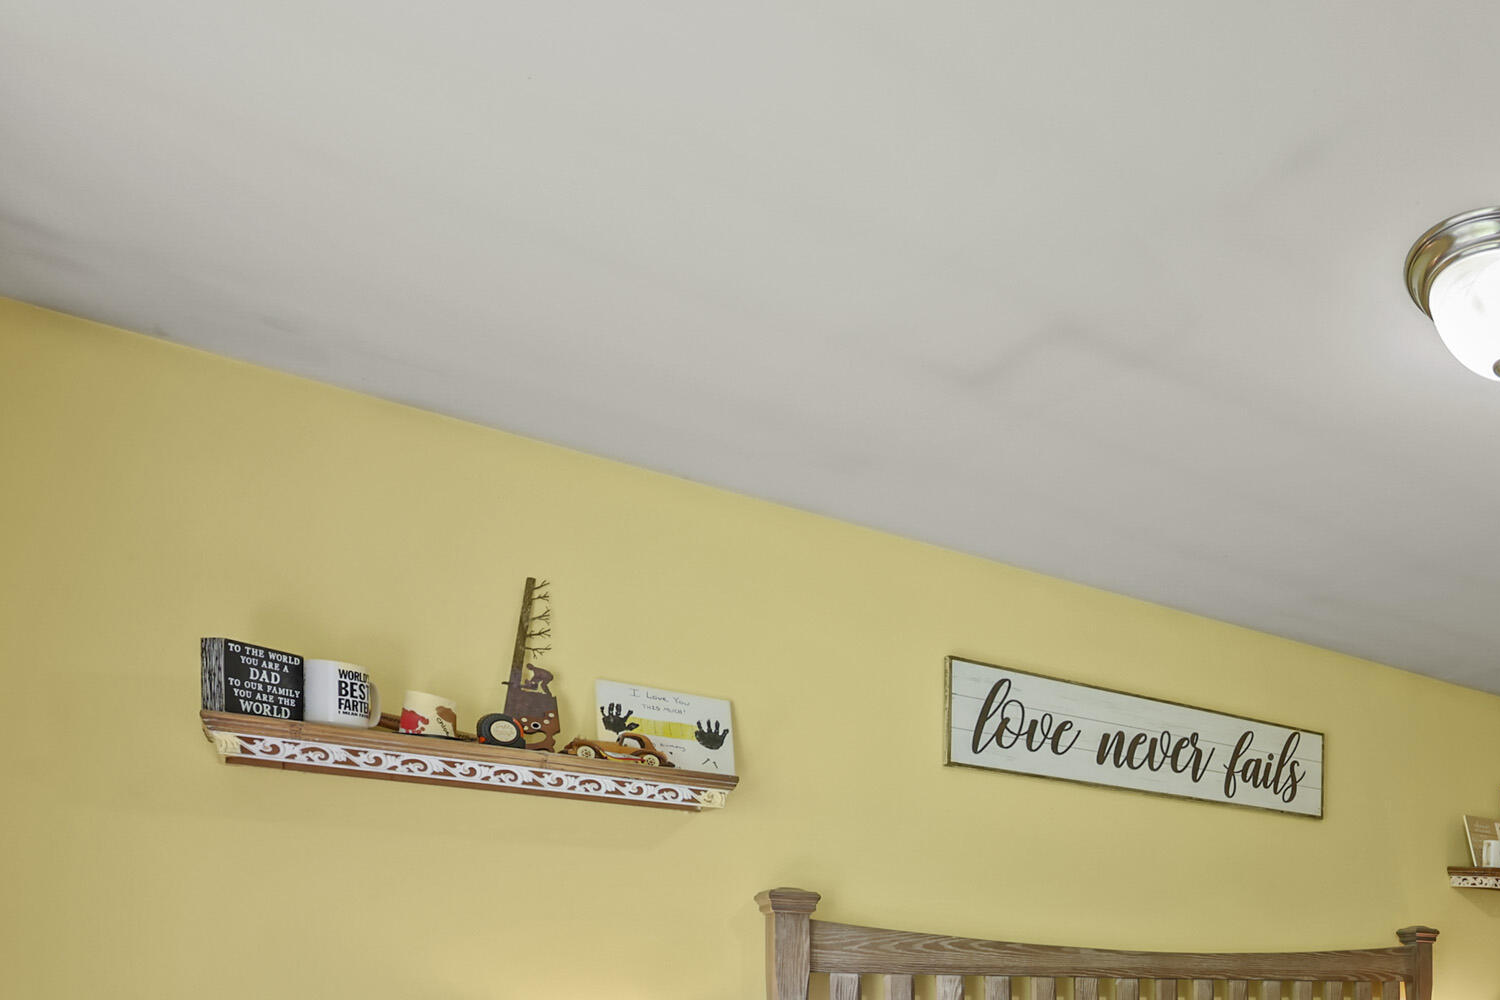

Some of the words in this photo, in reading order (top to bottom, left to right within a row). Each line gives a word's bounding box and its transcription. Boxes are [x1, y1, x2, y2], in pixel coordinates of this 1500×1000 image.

[228, 642, 241, 653] TO
[244, 646, 265, 658] THE
[268, 651, 301, 666] WORLD
[240, 655, 259, 666] YOU
[261, 660, 280, 671] ARE
[282, 665, 290, 673] A
[249, 667, 281, 685] DAD
[228, 677, 241, 687] TO
[244, 681, 264, 691] OUR
[267, 685, 301, 698] FAMILY
[233, 688, 252, 698] YOU
[255, 693, 274, 703] ARE
[278, 696, 296, 707] THE
[338, 680, 370, 701] BEST
[239, 699, 291, 719] WORLD
[972, 678, 1081, 755] love
[1096, 730, 1215, 783] never
[1223, 730, 1306, 803] fails
